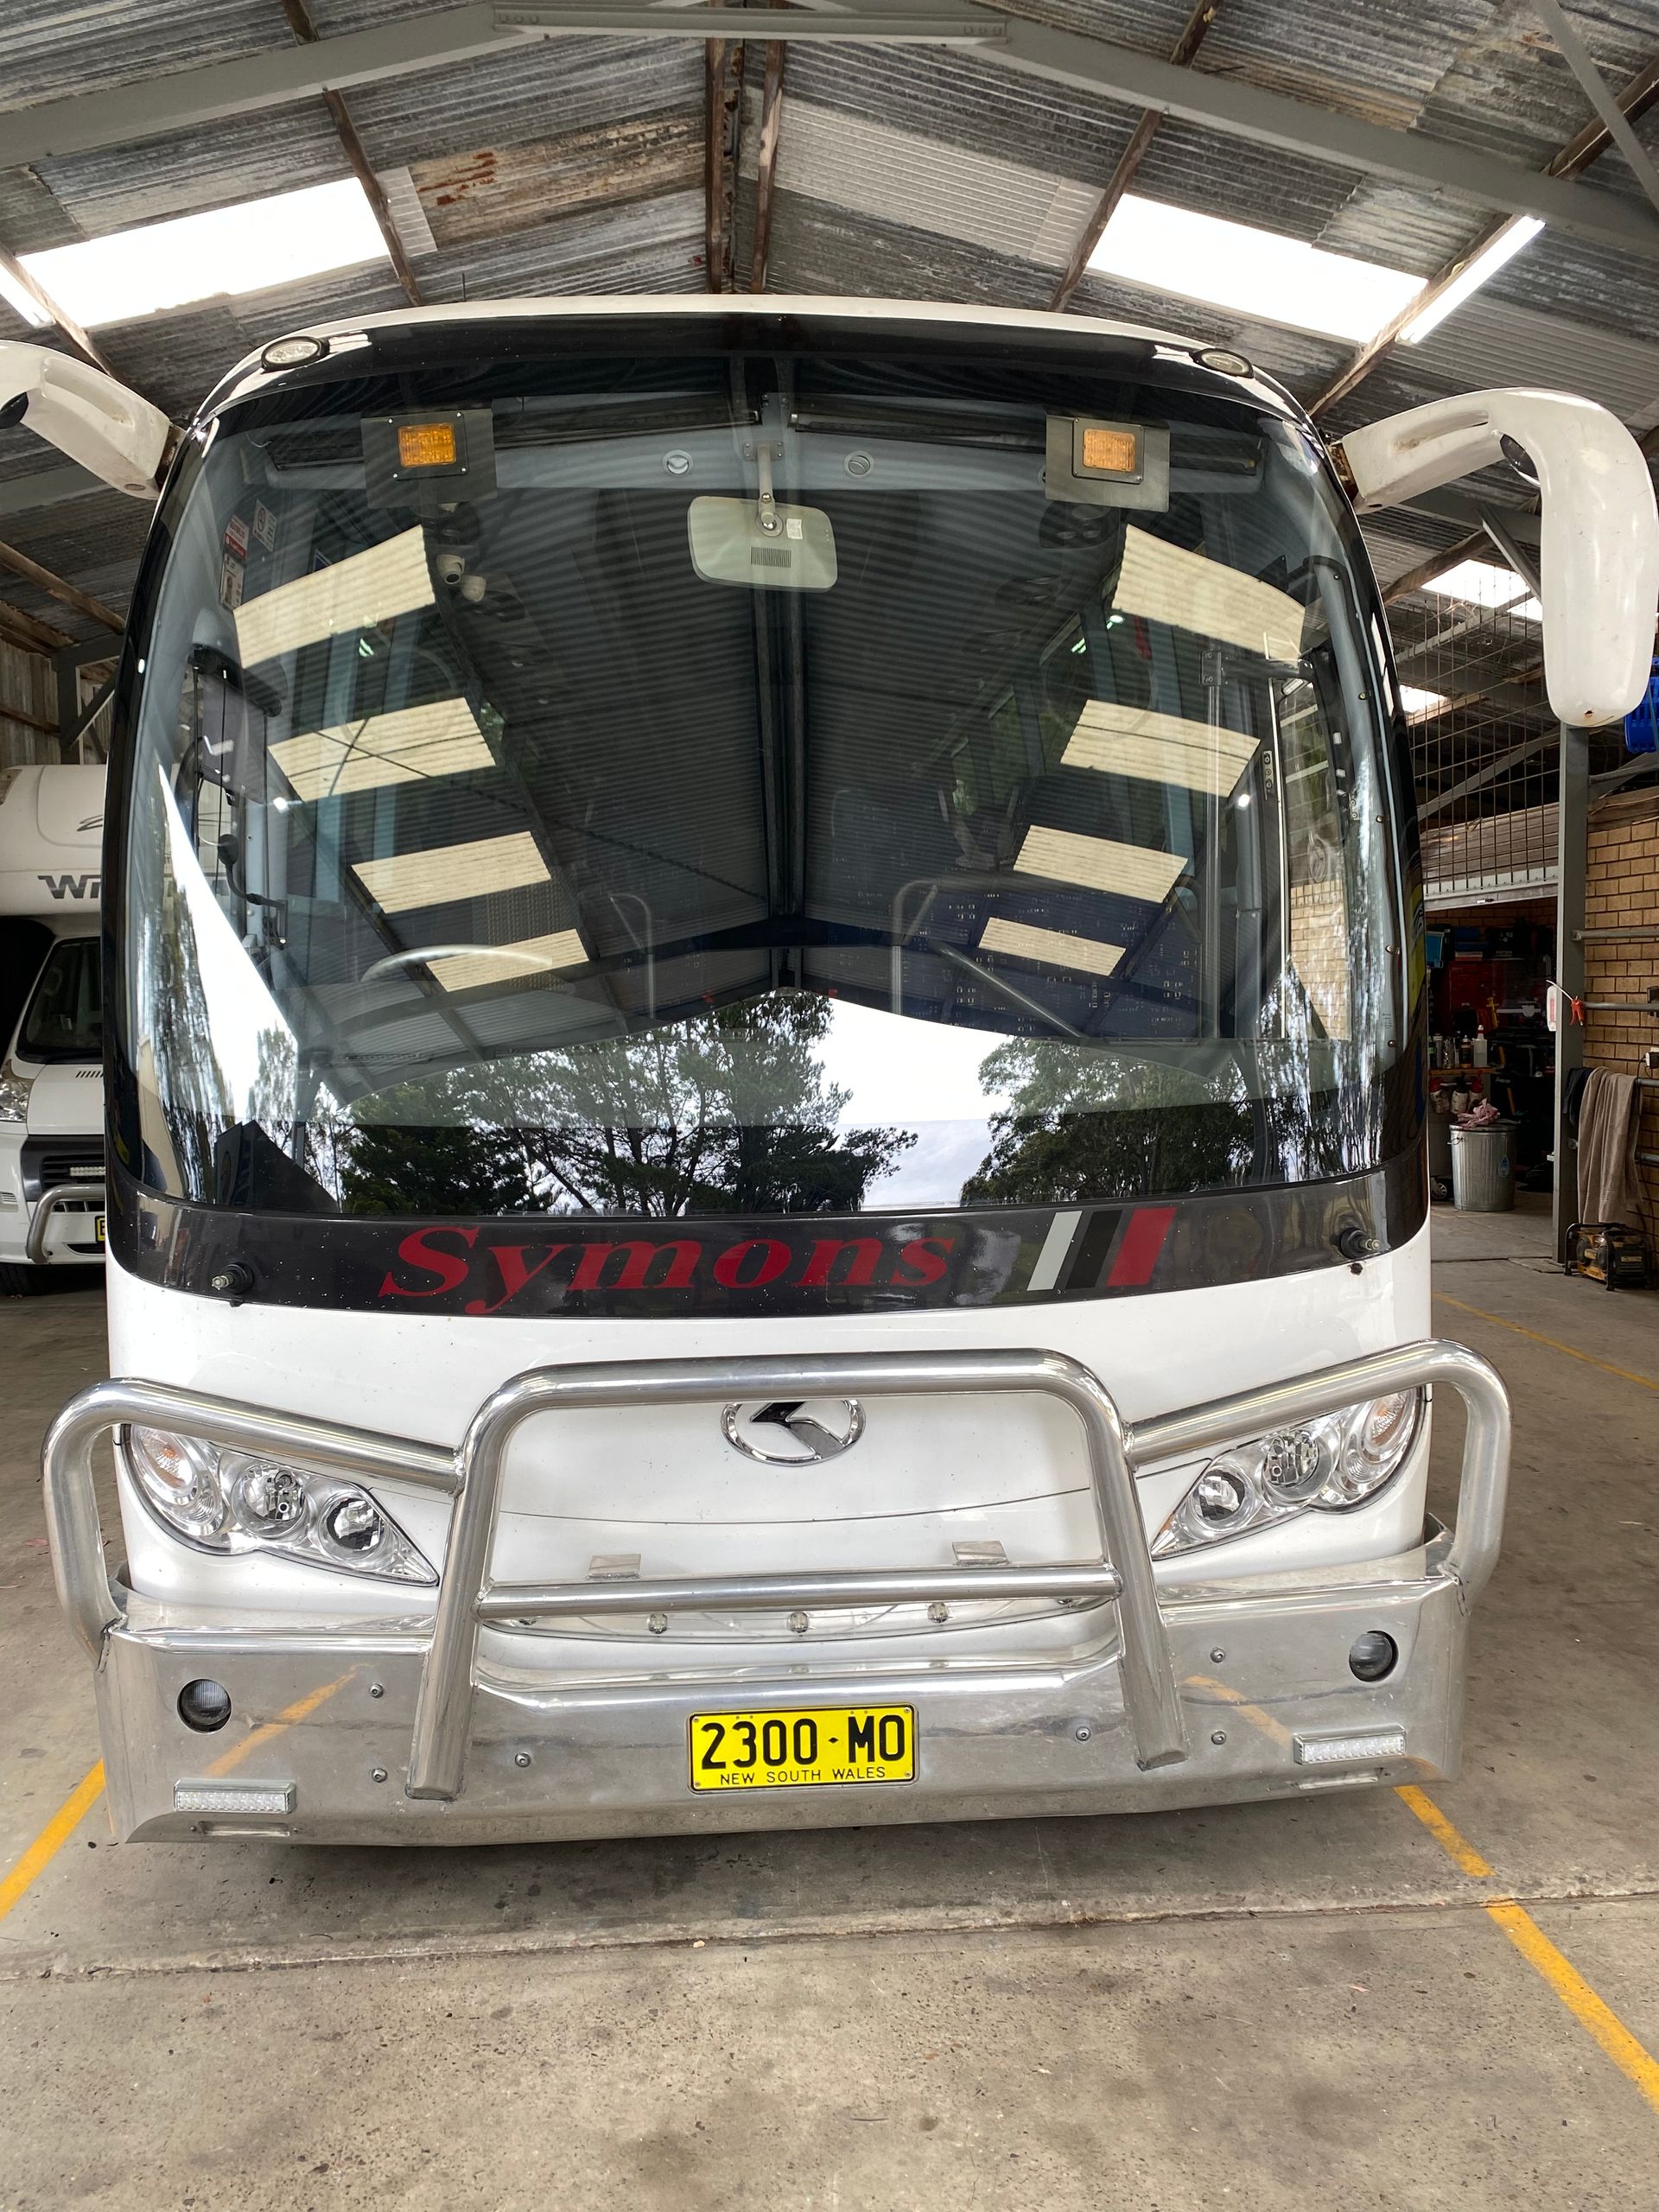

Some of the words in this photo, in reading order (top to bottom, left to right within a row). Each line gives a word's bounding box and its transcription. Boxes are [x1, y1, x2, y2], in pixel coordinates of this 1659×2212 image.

[379, 1225, 956, 1315] Symons
[720, 1772, 756, 1786] NEW
[766, 1769, 821, 1783] SOUTH
[832, 1766, 887, 1780] WALES
